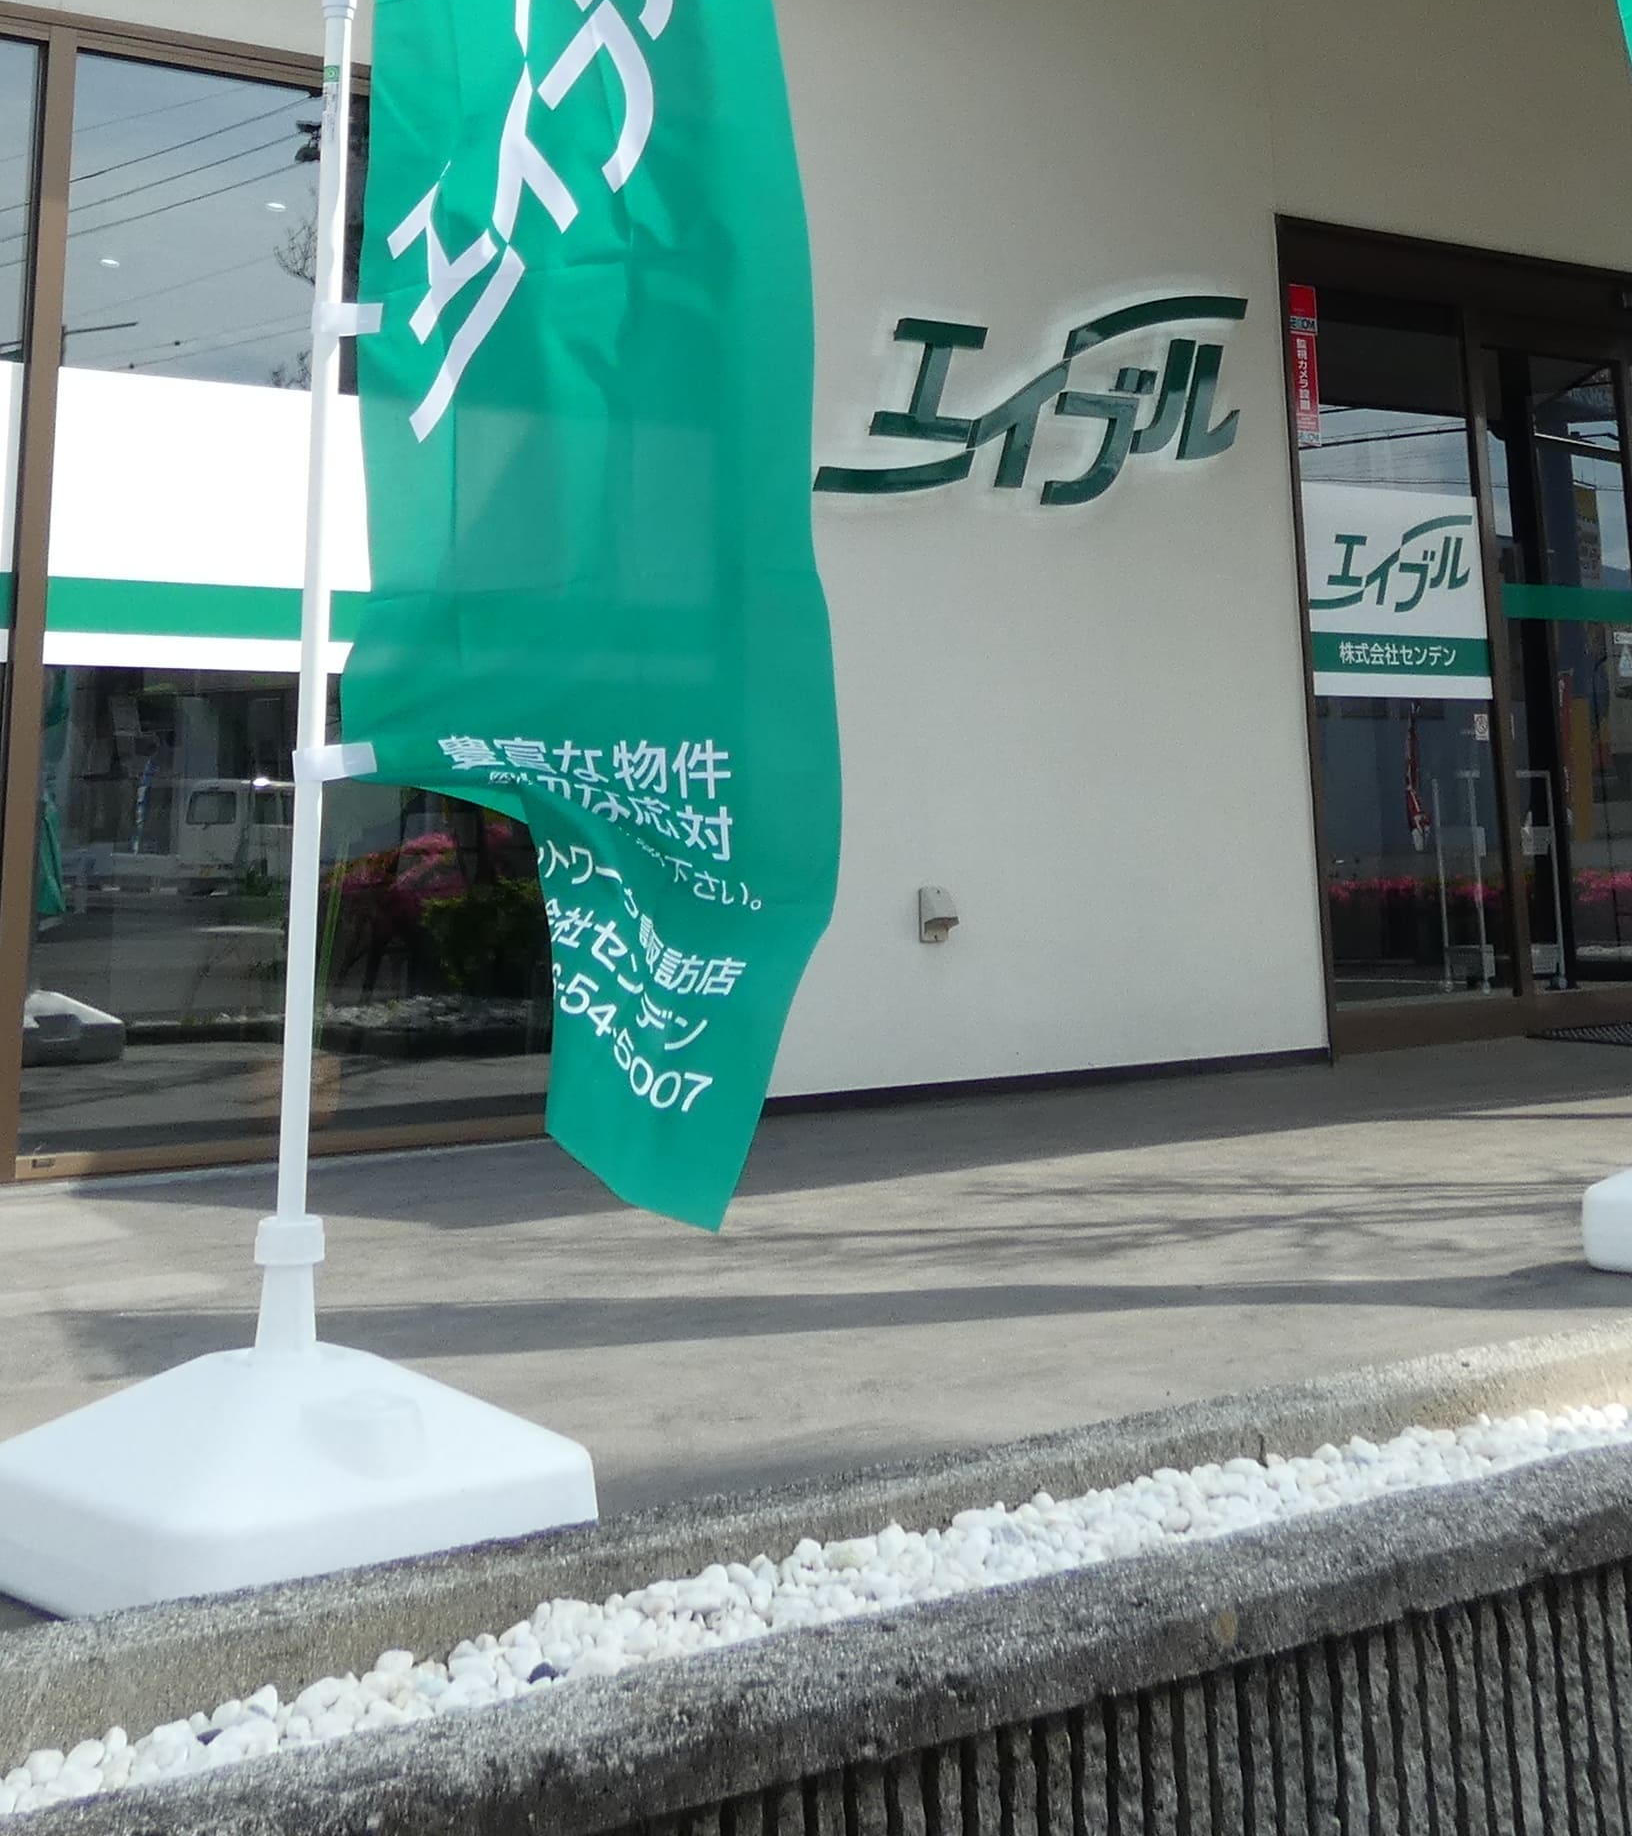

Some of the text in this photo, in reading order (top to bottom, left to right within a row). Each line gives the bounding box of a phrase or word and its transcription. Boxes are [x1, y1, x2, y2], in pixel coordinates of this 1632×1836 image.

[813, 295, 1248, 506] エイブル
[1309, 515, 1472, 613] エイブル
[1339, 640, 1456, 666] 株式会社センデン
